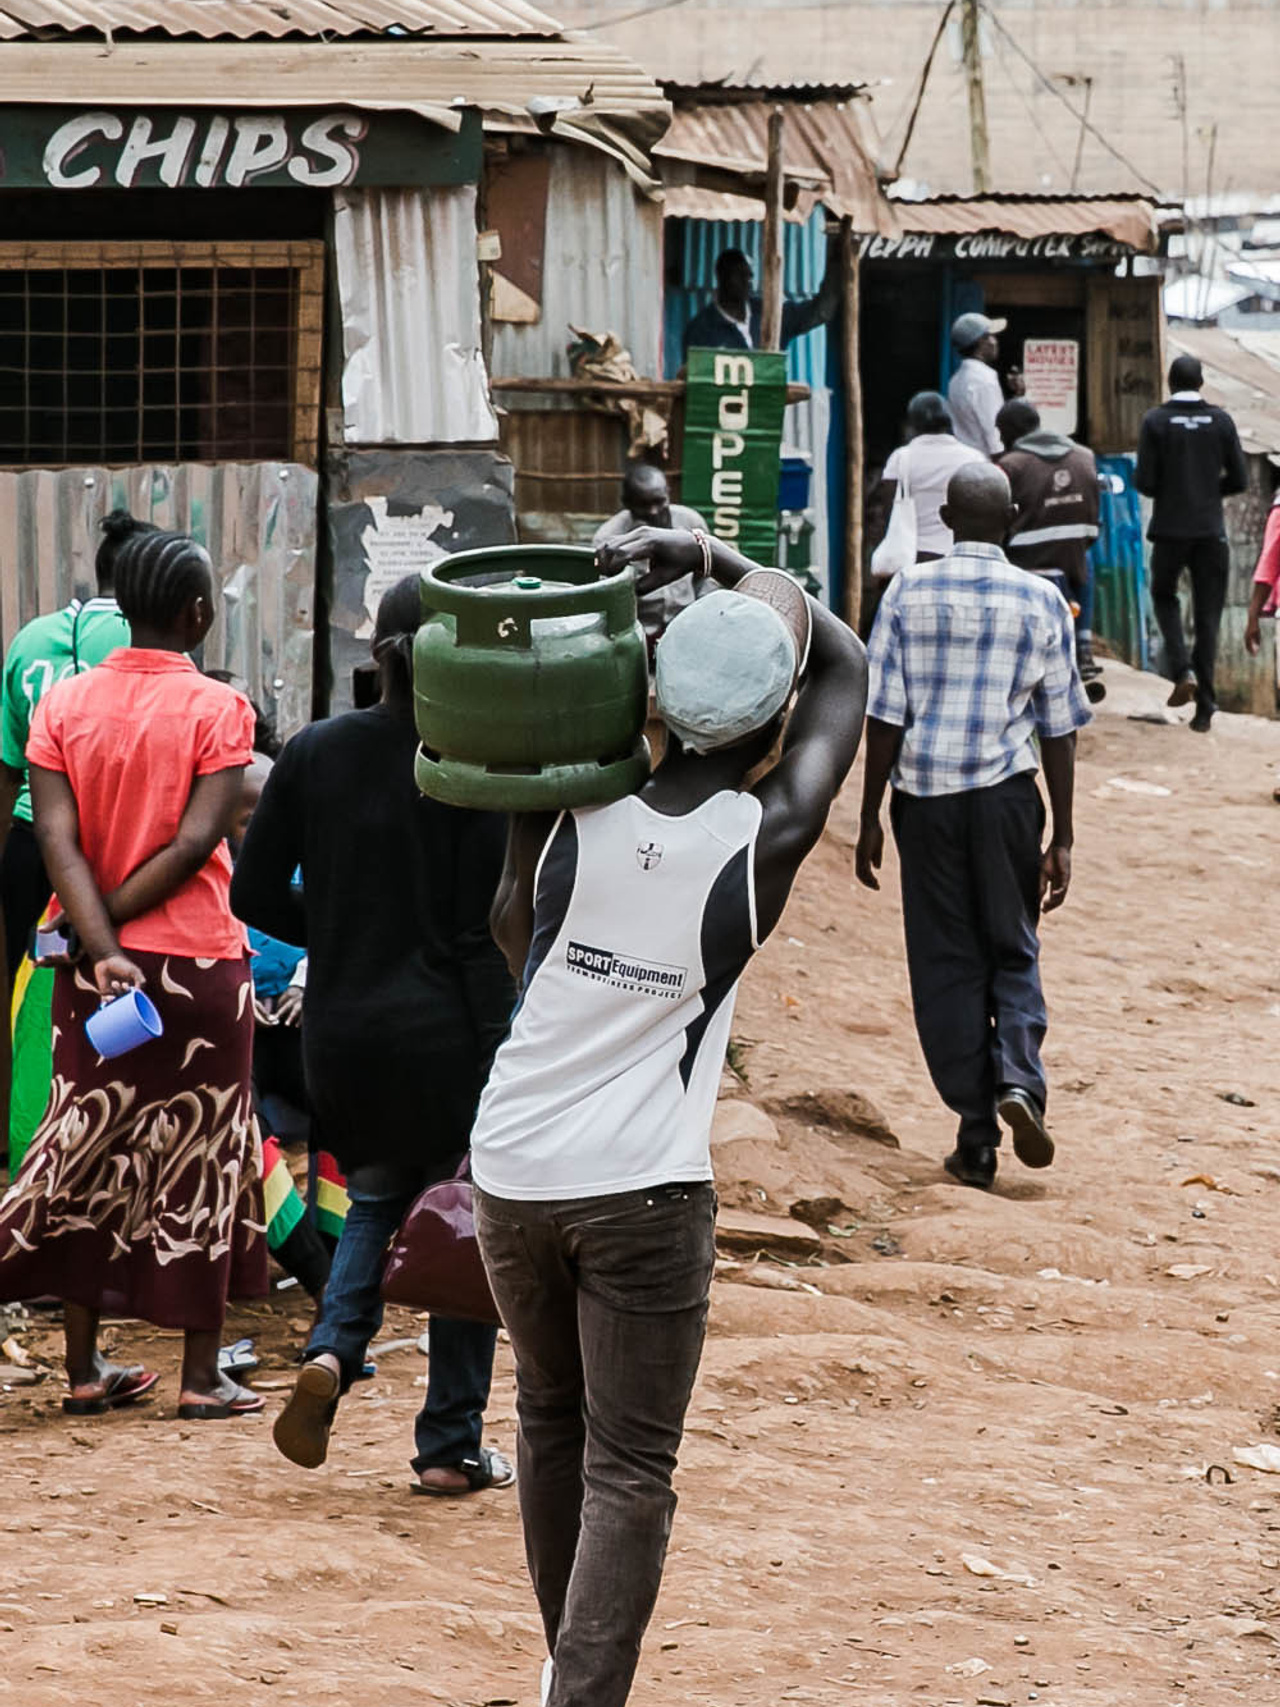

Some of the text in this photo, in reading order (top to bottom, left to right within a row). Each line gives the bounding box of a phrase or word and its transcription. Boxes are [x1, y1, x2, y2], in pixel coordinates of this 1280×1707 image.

[43, 112, 368, 188] CHIPS
[954, 233, 1078, 258] COMPUTER
[567, 946, 684, 988] SPORT Equipment
